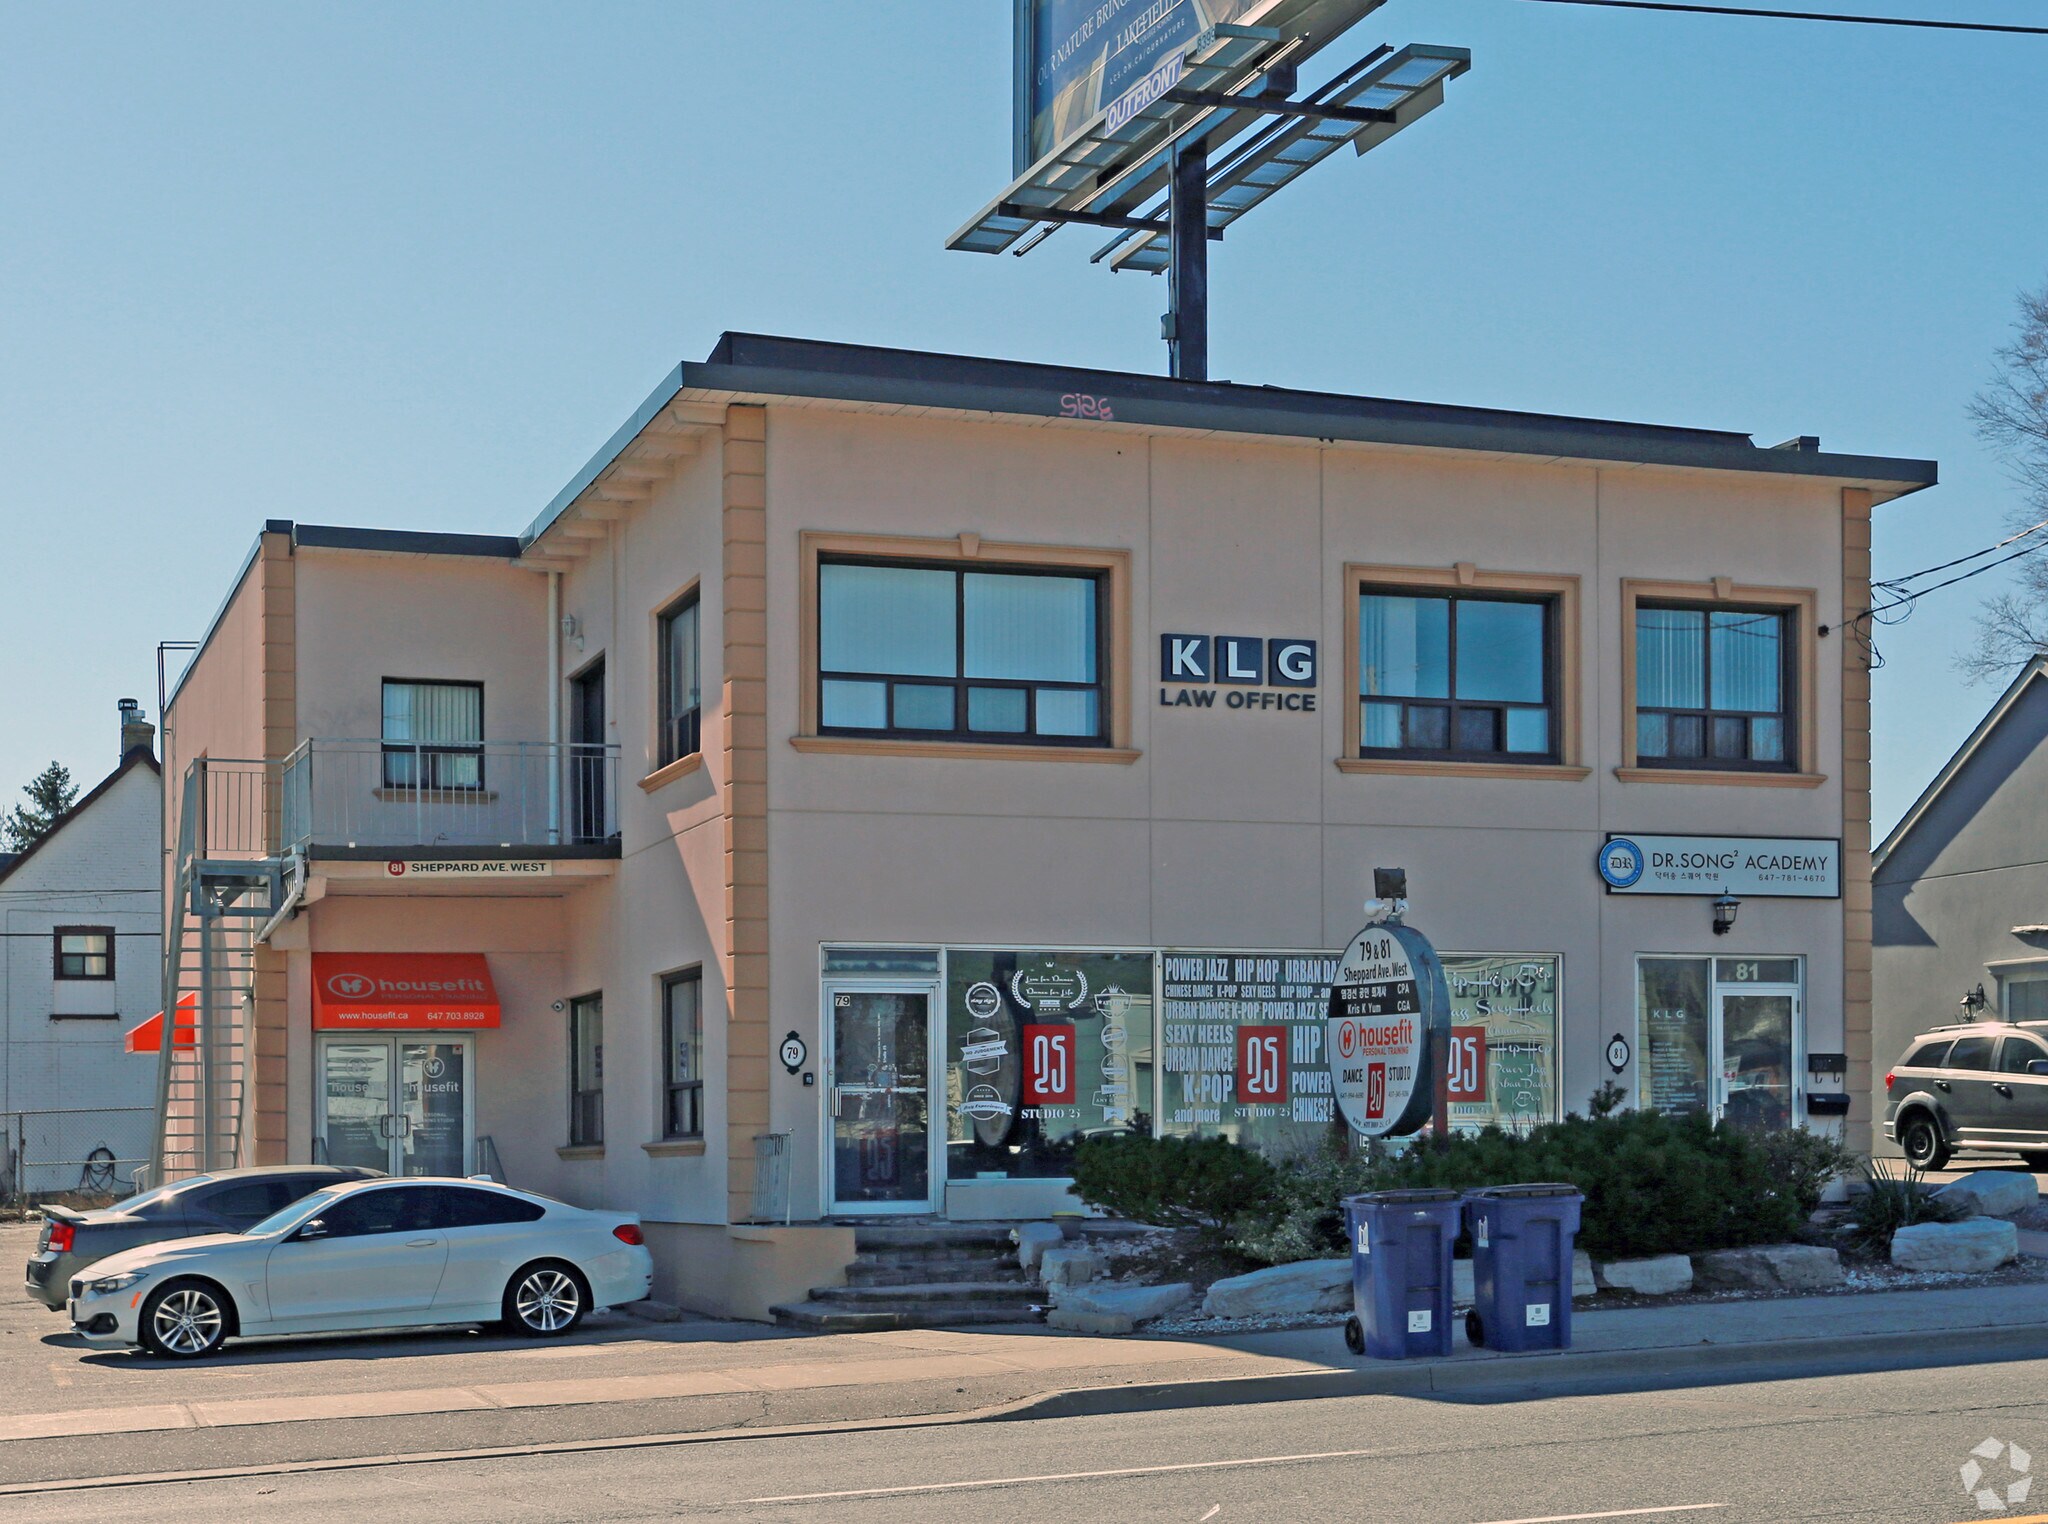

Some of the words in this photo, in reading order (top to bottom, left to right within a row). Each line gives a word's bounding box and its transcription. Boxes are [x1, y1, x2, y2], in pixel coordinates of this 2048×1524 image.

[1037, 54, 1056, 86] OUR
[1057, 15, 1094, 67] NATURE
[1108, 57, 1181, 127] OUTFRONT
[1160, 688, 1216, 708] LAW
[1226, 691, 1316, 711] OFFICE
[390, 862, 403, 873] 81
[411, 863, 479, 873] SHEPPARD
[481, 862, 508, 872] AVE.
[509, 862, 547, 872] WEST
[1745, 855, 1828, 870] ACADEMY
[1704, 872, 1719, 881] 학원
[1758, 874, 1826, 882] 647-781-4670
[1360, 941, 1372, 961] 79
[1373, 944, 1380, 960] &
[1380, 938, 1391, 959] 81
[1165, 957, 1204, 981] POWER
[1205, 957, 1229, 982] JAZZ
[1234, 958, 1255, 982] HIP
[1256, 958, 1280, 983] HOP
[1285, 959, 1322, 983] URBAN
[1323, 960, 1340, 983] DA
[1344, 964, 1376, 985] Sheppard
[1378, 964, 1391, 978] Ave.
[1391, 962, 1408, 977] West
[1735, 963, 1759, 981] 81
[378, 978, 486, 992] housefit
[1165, 984, 1192, 998] CHINESE
[1192, 984, 1214, 998] DANCE
[1216, 984, 1238, 998] K-POP
[1240, 985, 1257, 998] SEXY
[1257, 985, 1276, 998] HEELS
[1280, 985, 1295, 999] HIP
[1296, 985, 1314, 999] HOP
[1397, 983, 1410, 994] CPA
[835, 996, 850, 1006] 79
[1397, 1000, 1411, 1012] CGA
[338, 1011, 409, 1020] www.housefit.ca
[427, 1012, 485, 1020] 647.703.8928
[1165, 1002, 1197, 1020] URBAN
[1199, 1002, 1231, 1020] DANCE
[1231, 1002, 1260, 1020] K-POP
[1262, 1002, 1295, 1020] POWER
[1296, 1002, 1316, 1020] JAZZ
[1319, 1002, 1329, 1020] SE
[1347, 1003, 1360, 1015] Kris
[1361, 1003, 1367, 1014] K
[1450, 1007, 1470, 1021] azz
[1475, 999, 1512, 1018] Sexy
[1512, 997, 1553, 1020] Heels
[1165, 1025, 1197, 1044] SEXY
[1198, 1025, 1234, 1044] HEELS
[1359, 1018, 1413, 1047] housefit
[1292, 1025, 1321, 1064] HIP
[1362, 1047, 1387, 1056] PERSONAL
[1388, 1046, 1409, 1055] TRAINING
[787, 1046, 799, 1060] 79
[1165, 1047, 1198, 1072] URBAN
[1201, 1047, 1233, 1072] DANCE
[1613, 1045, 1623, 1060] 81
[1343, 1069, 1363, 1083] DANCE
[1388, 1066, 1411, 1081] STUDIO
[409, 1081, 459, 1093] husefit
[1183, 1074, 1233, 1103] K-POP
[1292, 1071, 1332, 1094] POWER
[1021, 1108, 1065, 1119] STUDIO
[1194, 1110, 1220, 1123] more
[1234, 1107, 1275, 1118] STUDIO
[1292, 1097, 1329, 1122] CHINESE
